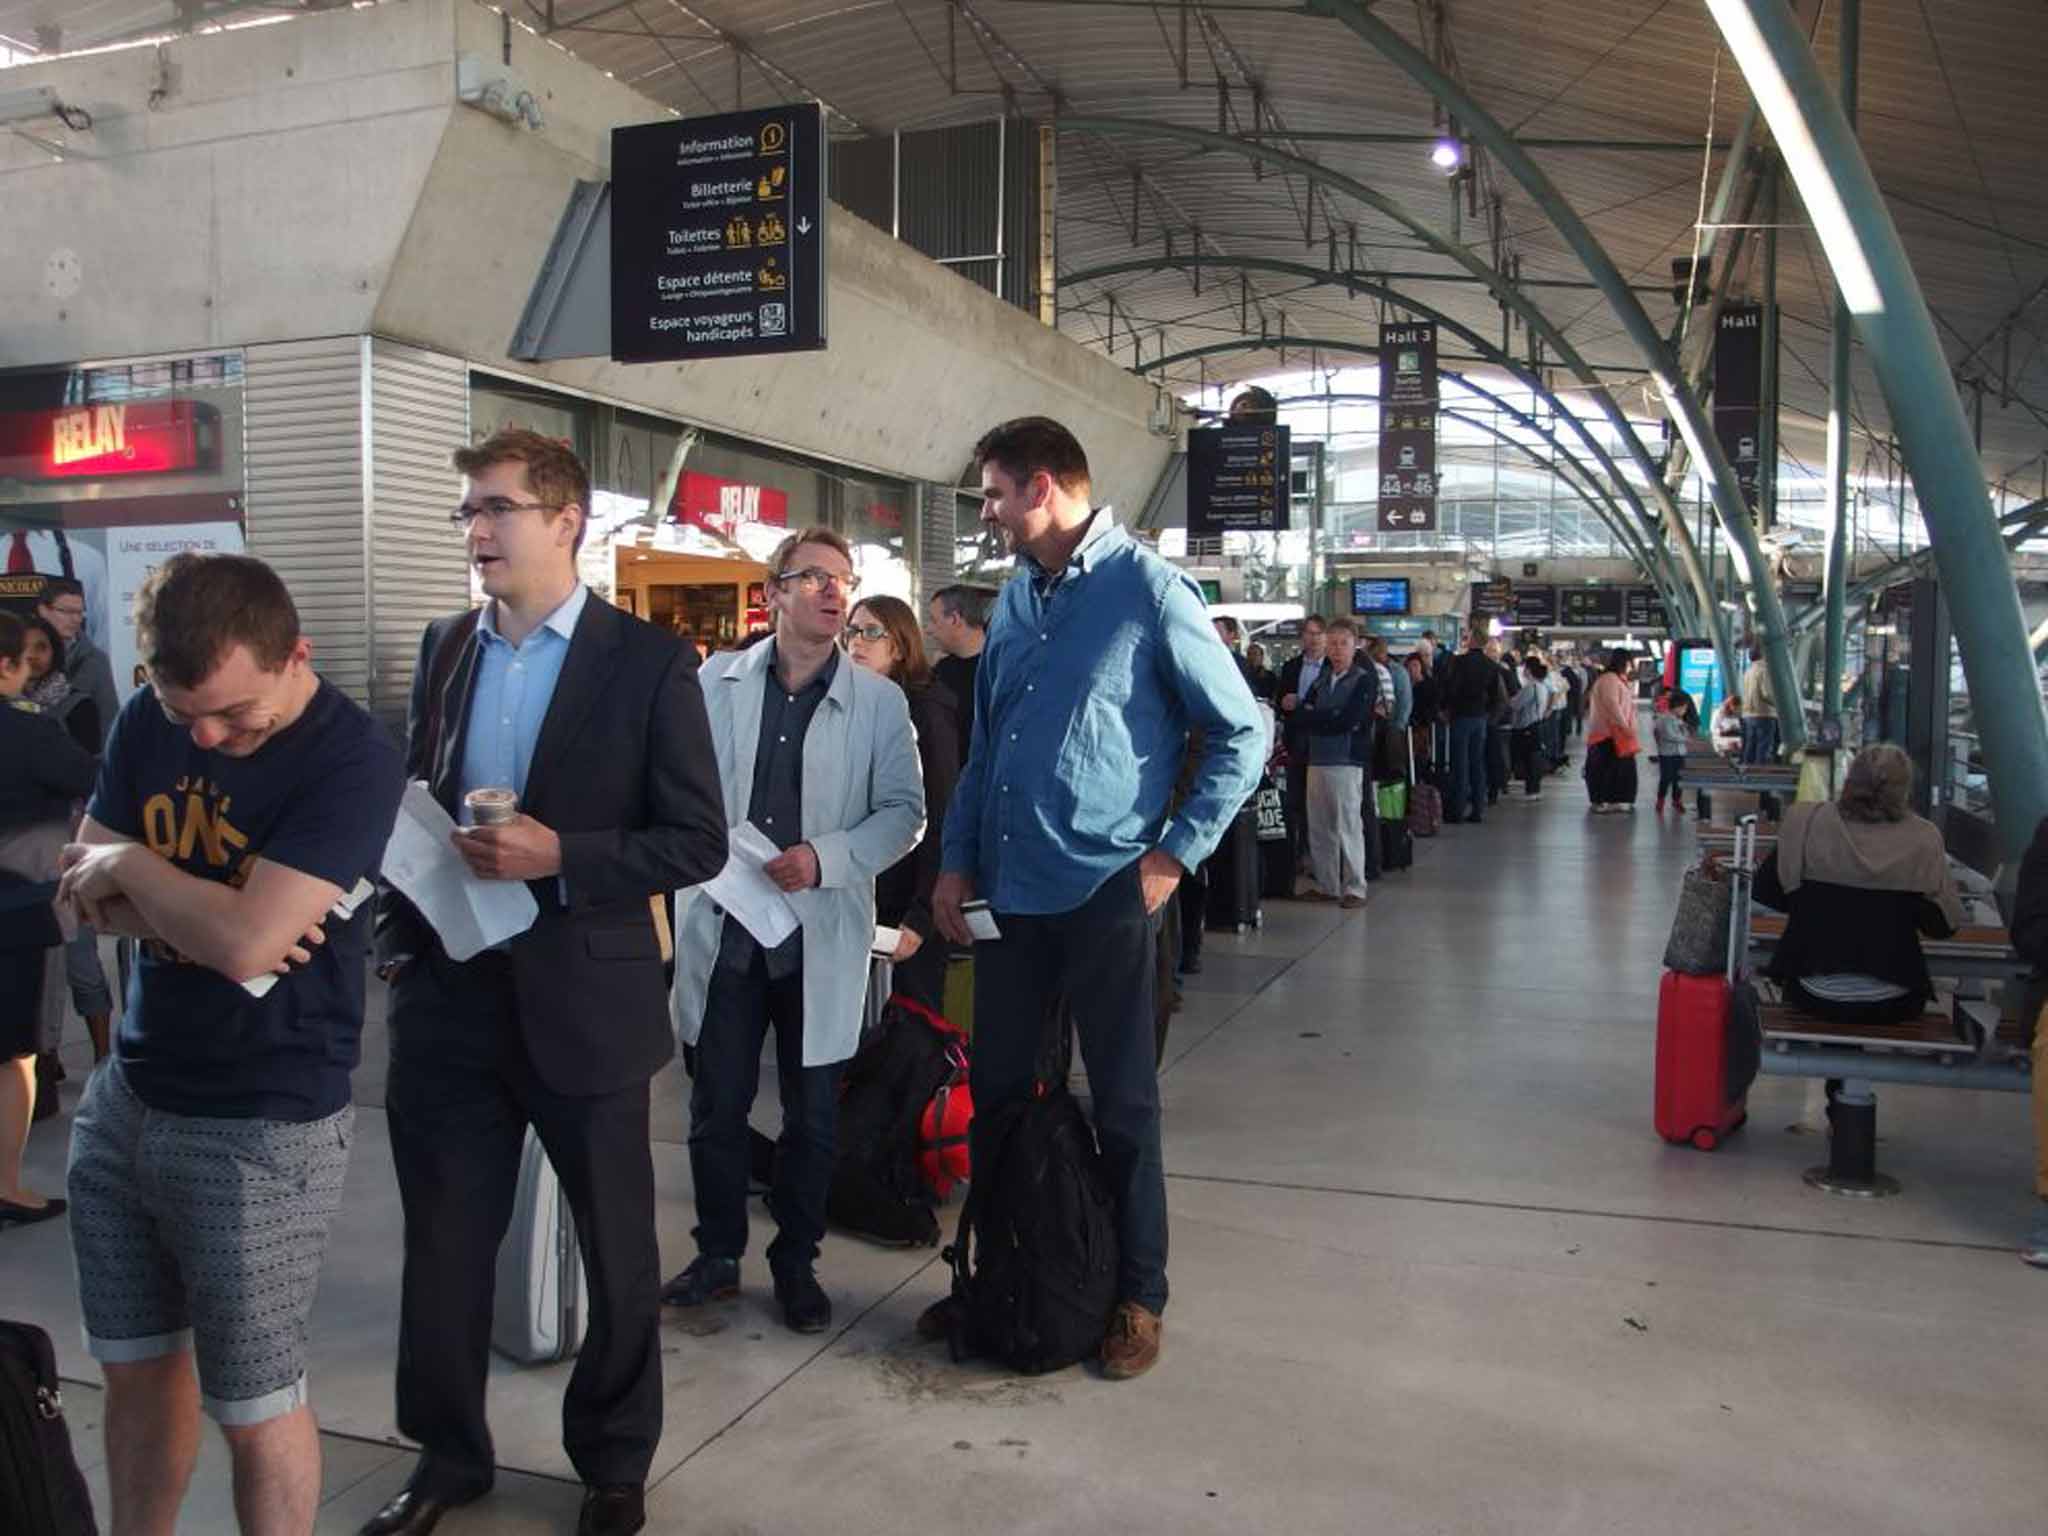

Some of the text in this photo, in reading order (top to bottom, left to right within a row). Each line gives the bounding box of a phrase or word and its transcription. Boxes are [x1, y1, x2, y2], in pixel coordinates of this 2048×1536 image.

[679, 135, 753, 155] Information
[690, 179, 753, 198] Billetterie
[668, 228, 721, 245] Toilettes
[657, 269, 753, 291] Espace détente
[649, 310, 754, 331] Espace voyageurs
[1721, 314, 1757, 328] Hall
[686, 325, 754, 342] handicapés
[1386, 329, 1432, 344] Hall 3
[53, 404, 126, 464] RELAY
